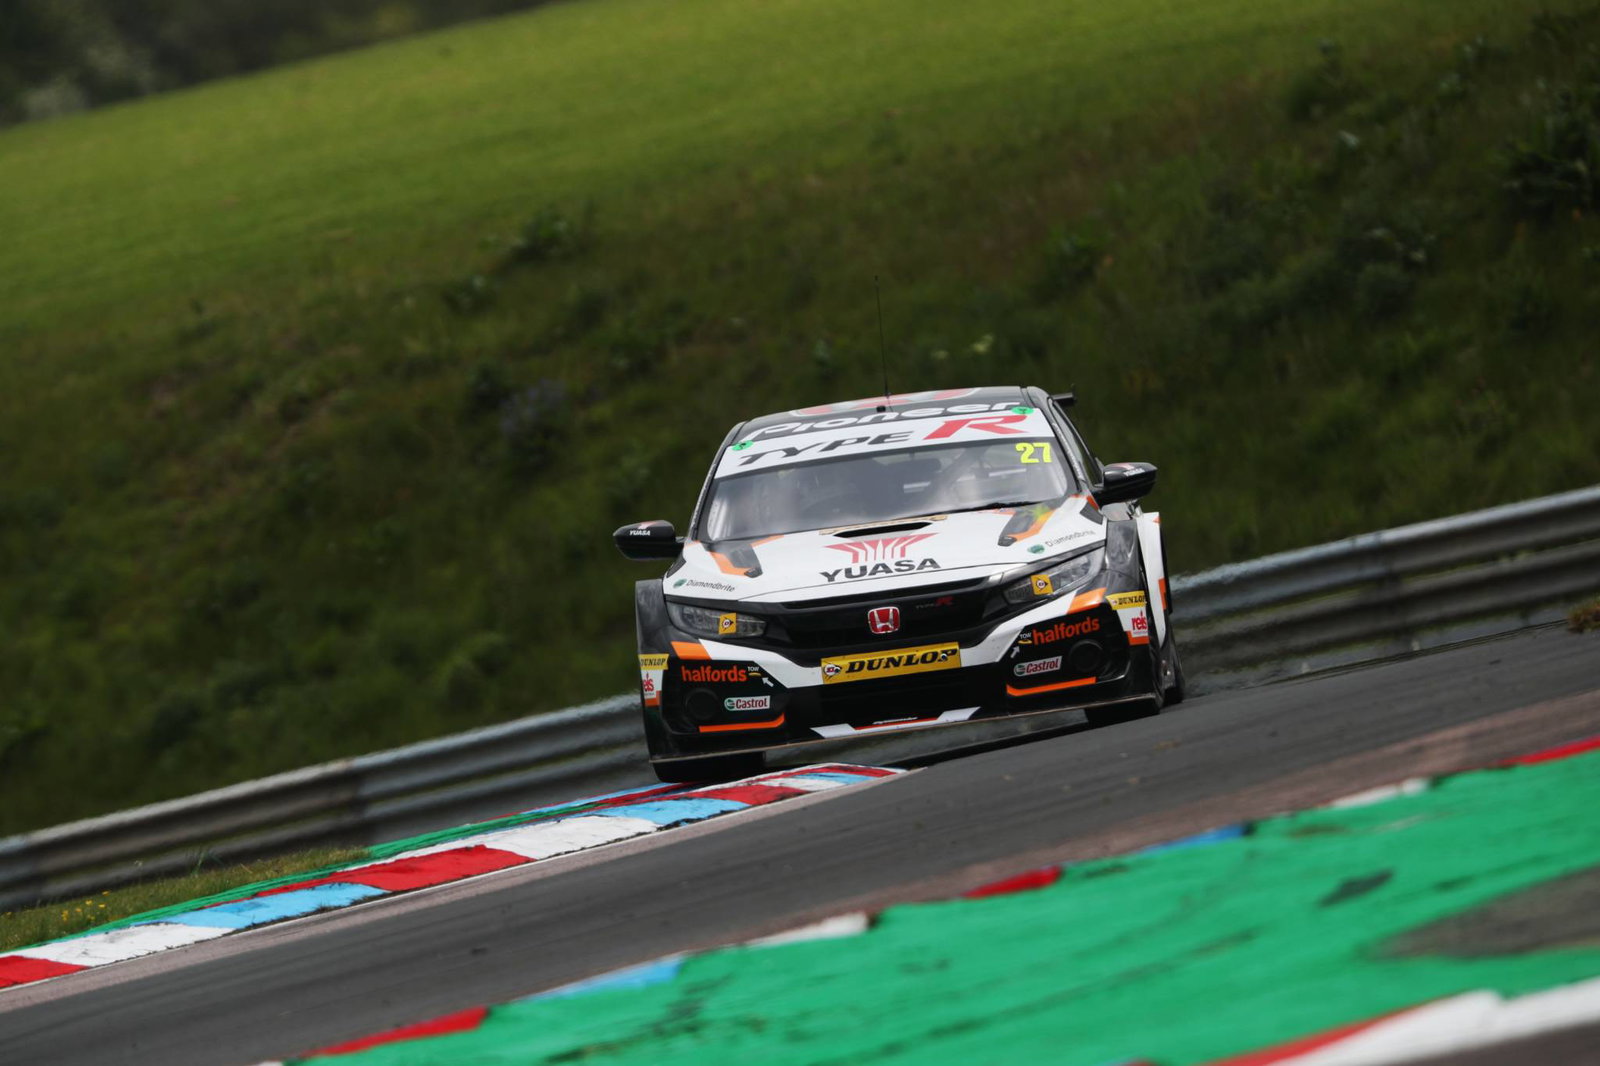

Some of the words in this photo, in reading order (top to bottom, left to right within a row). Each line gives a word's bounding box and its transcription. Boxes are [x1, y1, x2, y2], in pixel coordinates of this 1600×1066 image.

[739, 431, 914, 466] TYPE
[923, 415, 1028, 440] R
[1015, 443, 1052, 464] 27
[820, 558, 941, 583] YUASA
[686, 579, 735, 592] Diamondbrite
[1032, 616, 1100, 645] halfords
[845, 649, 958, 673] DUNLOP
[1026, 659, 1059, 674] Castrol
[681, 665, 747, 682] halfords
[735, 697, 768, 709] Castrol
